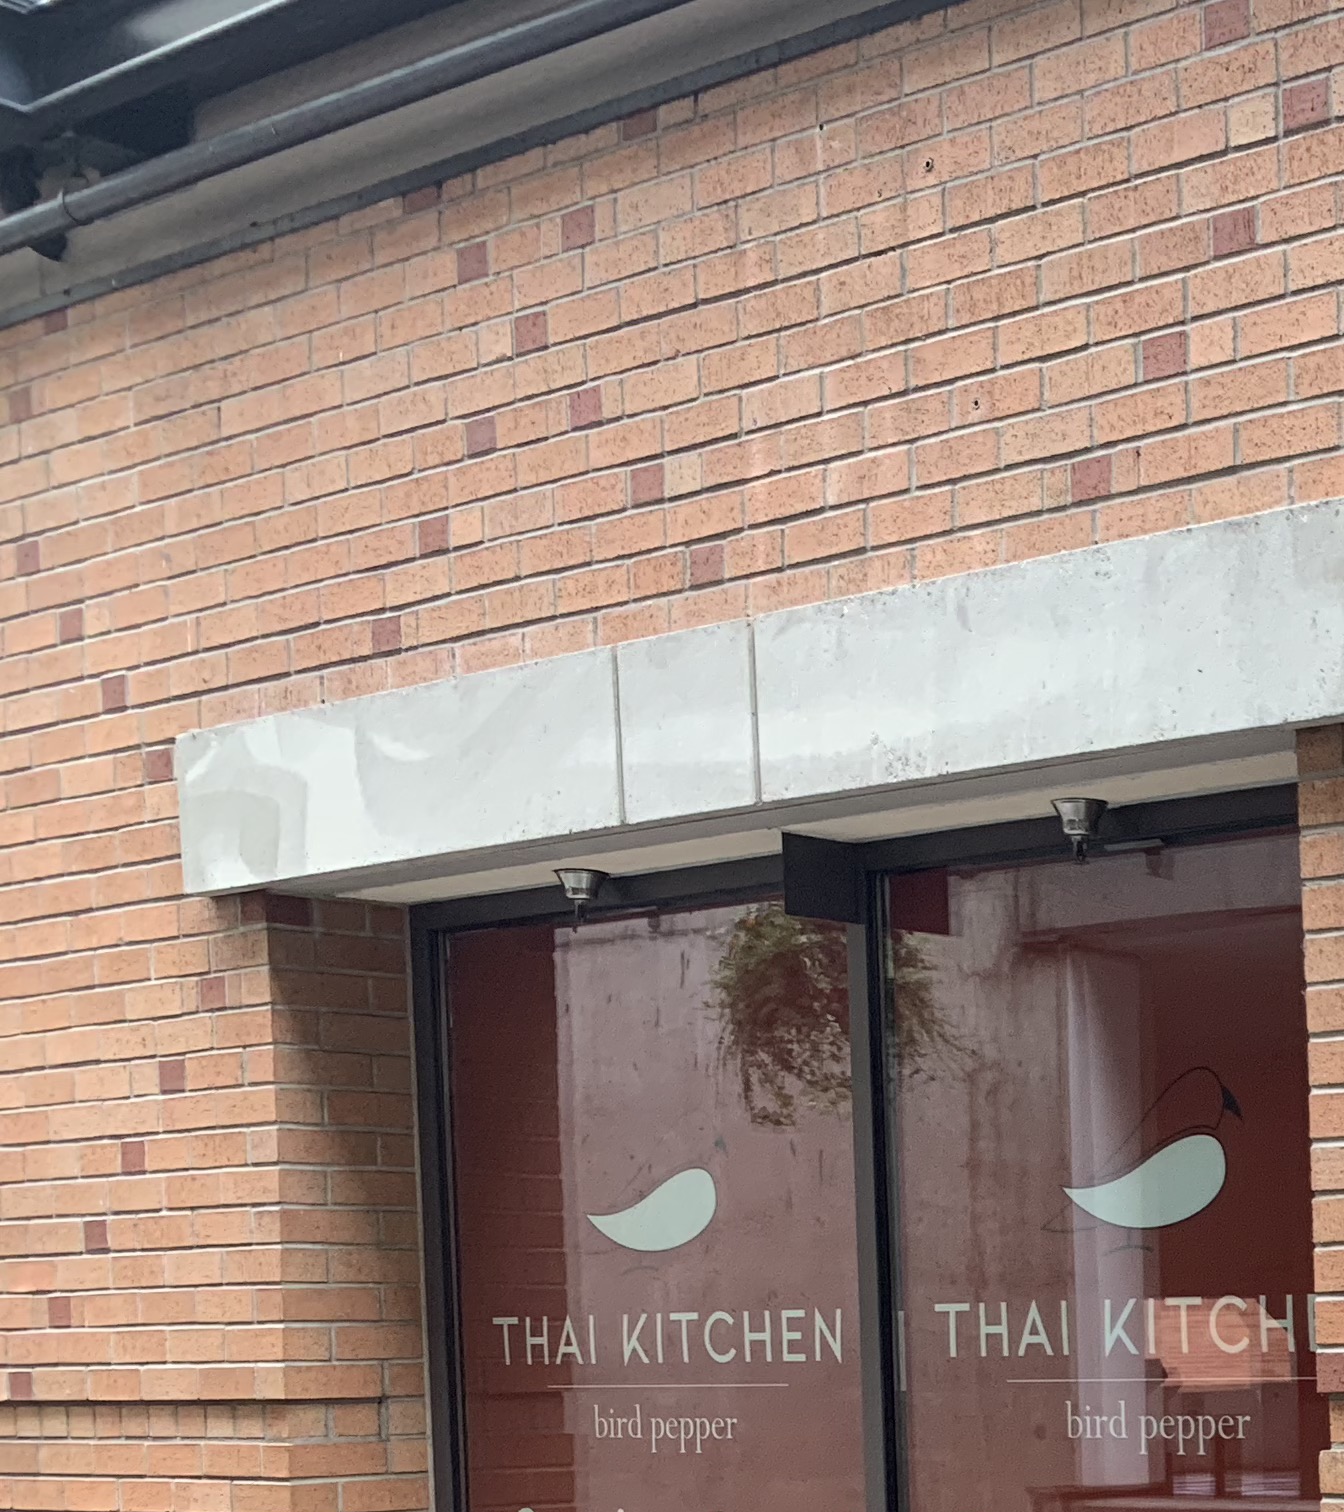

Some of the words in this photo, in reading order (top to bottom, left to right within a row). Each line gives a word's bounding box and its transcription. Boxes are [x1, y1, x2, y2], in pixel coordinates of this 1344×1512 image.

[492, 1314, 596, 1366] THAI
[623, 1308, 843, 1365] KITCHEN
[934, 1301, 1071, 1359] THAI
[1103, 1294, 1317, 1356] KITCH
[593, 1405, 642, 1442] bird
[648, 1413, 738, 1453] pepper
[1066, 1400, 1128, 1442] bird
[1139, 1410, 1251, 1455] pepper
